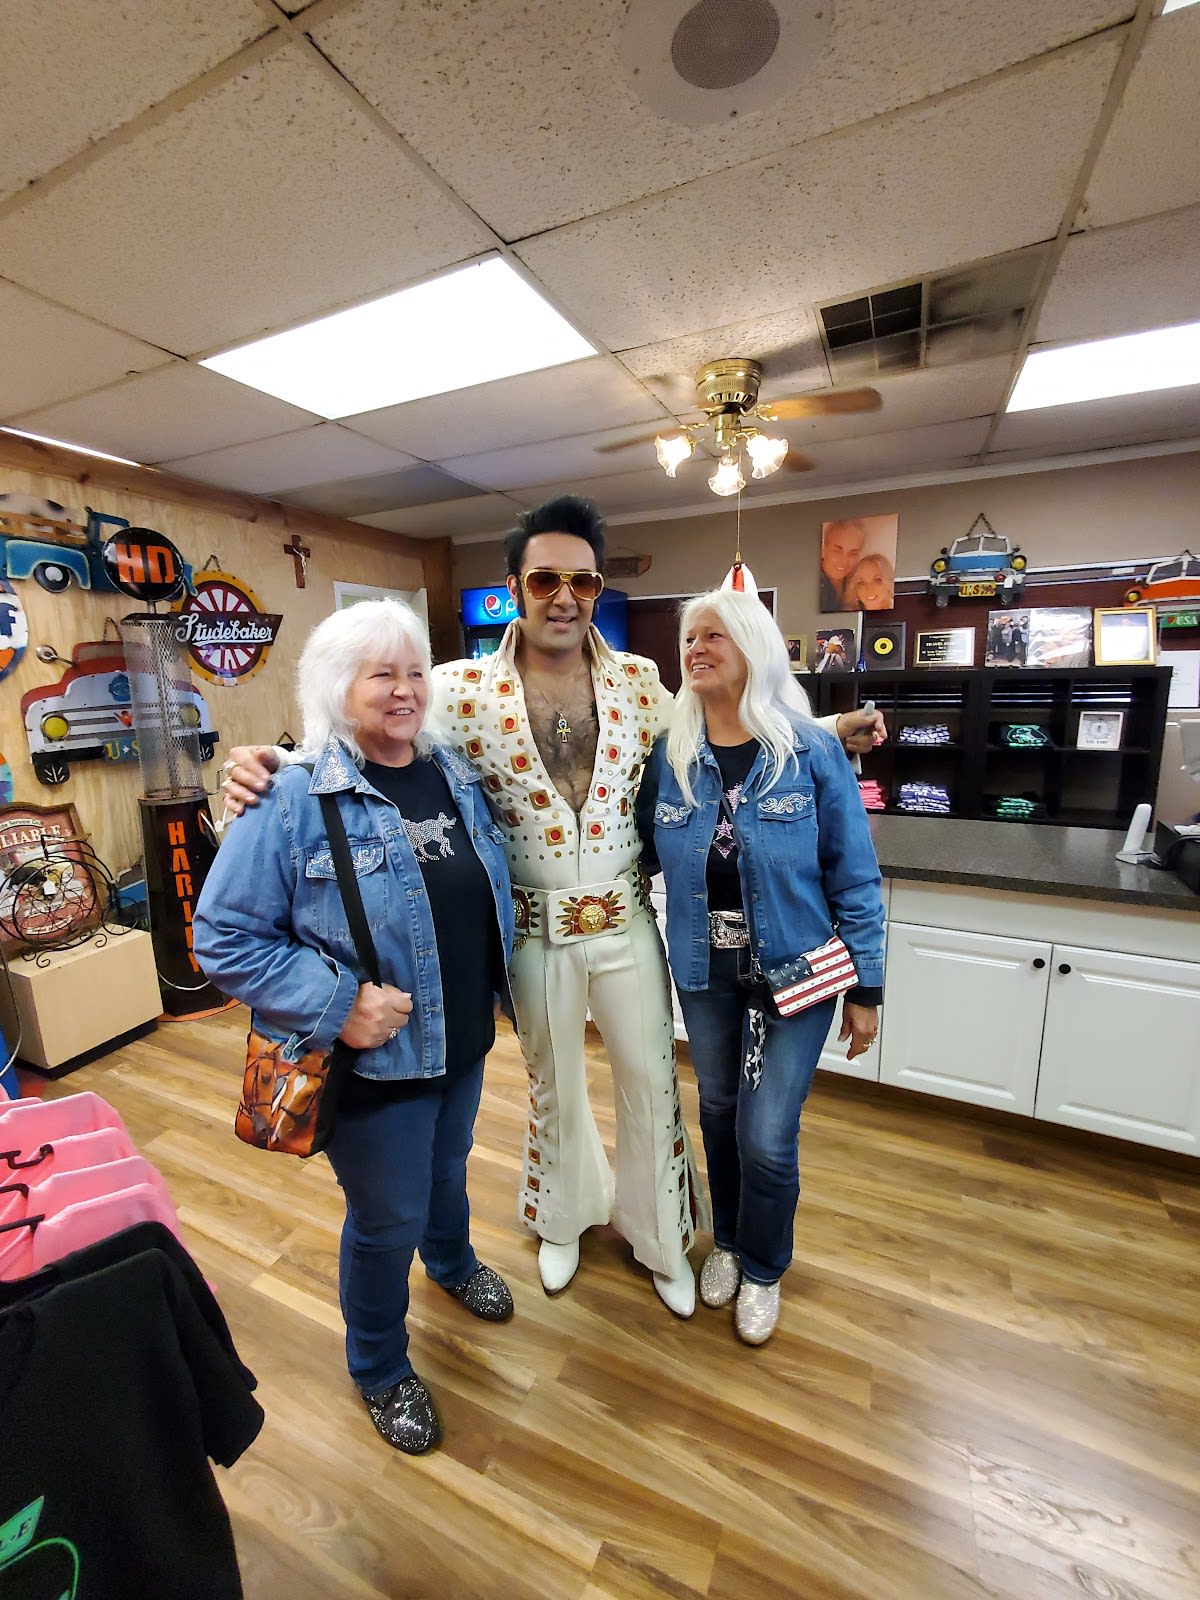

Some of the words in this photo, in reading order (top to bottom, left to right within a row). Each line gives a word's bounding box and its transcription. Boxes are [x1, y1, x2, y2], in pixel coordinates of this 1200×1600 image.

[116, 543, 175, 584] HD
[175, 612, 273, 643] Studebaker
[0, 826, 64, 849] LIABLE
